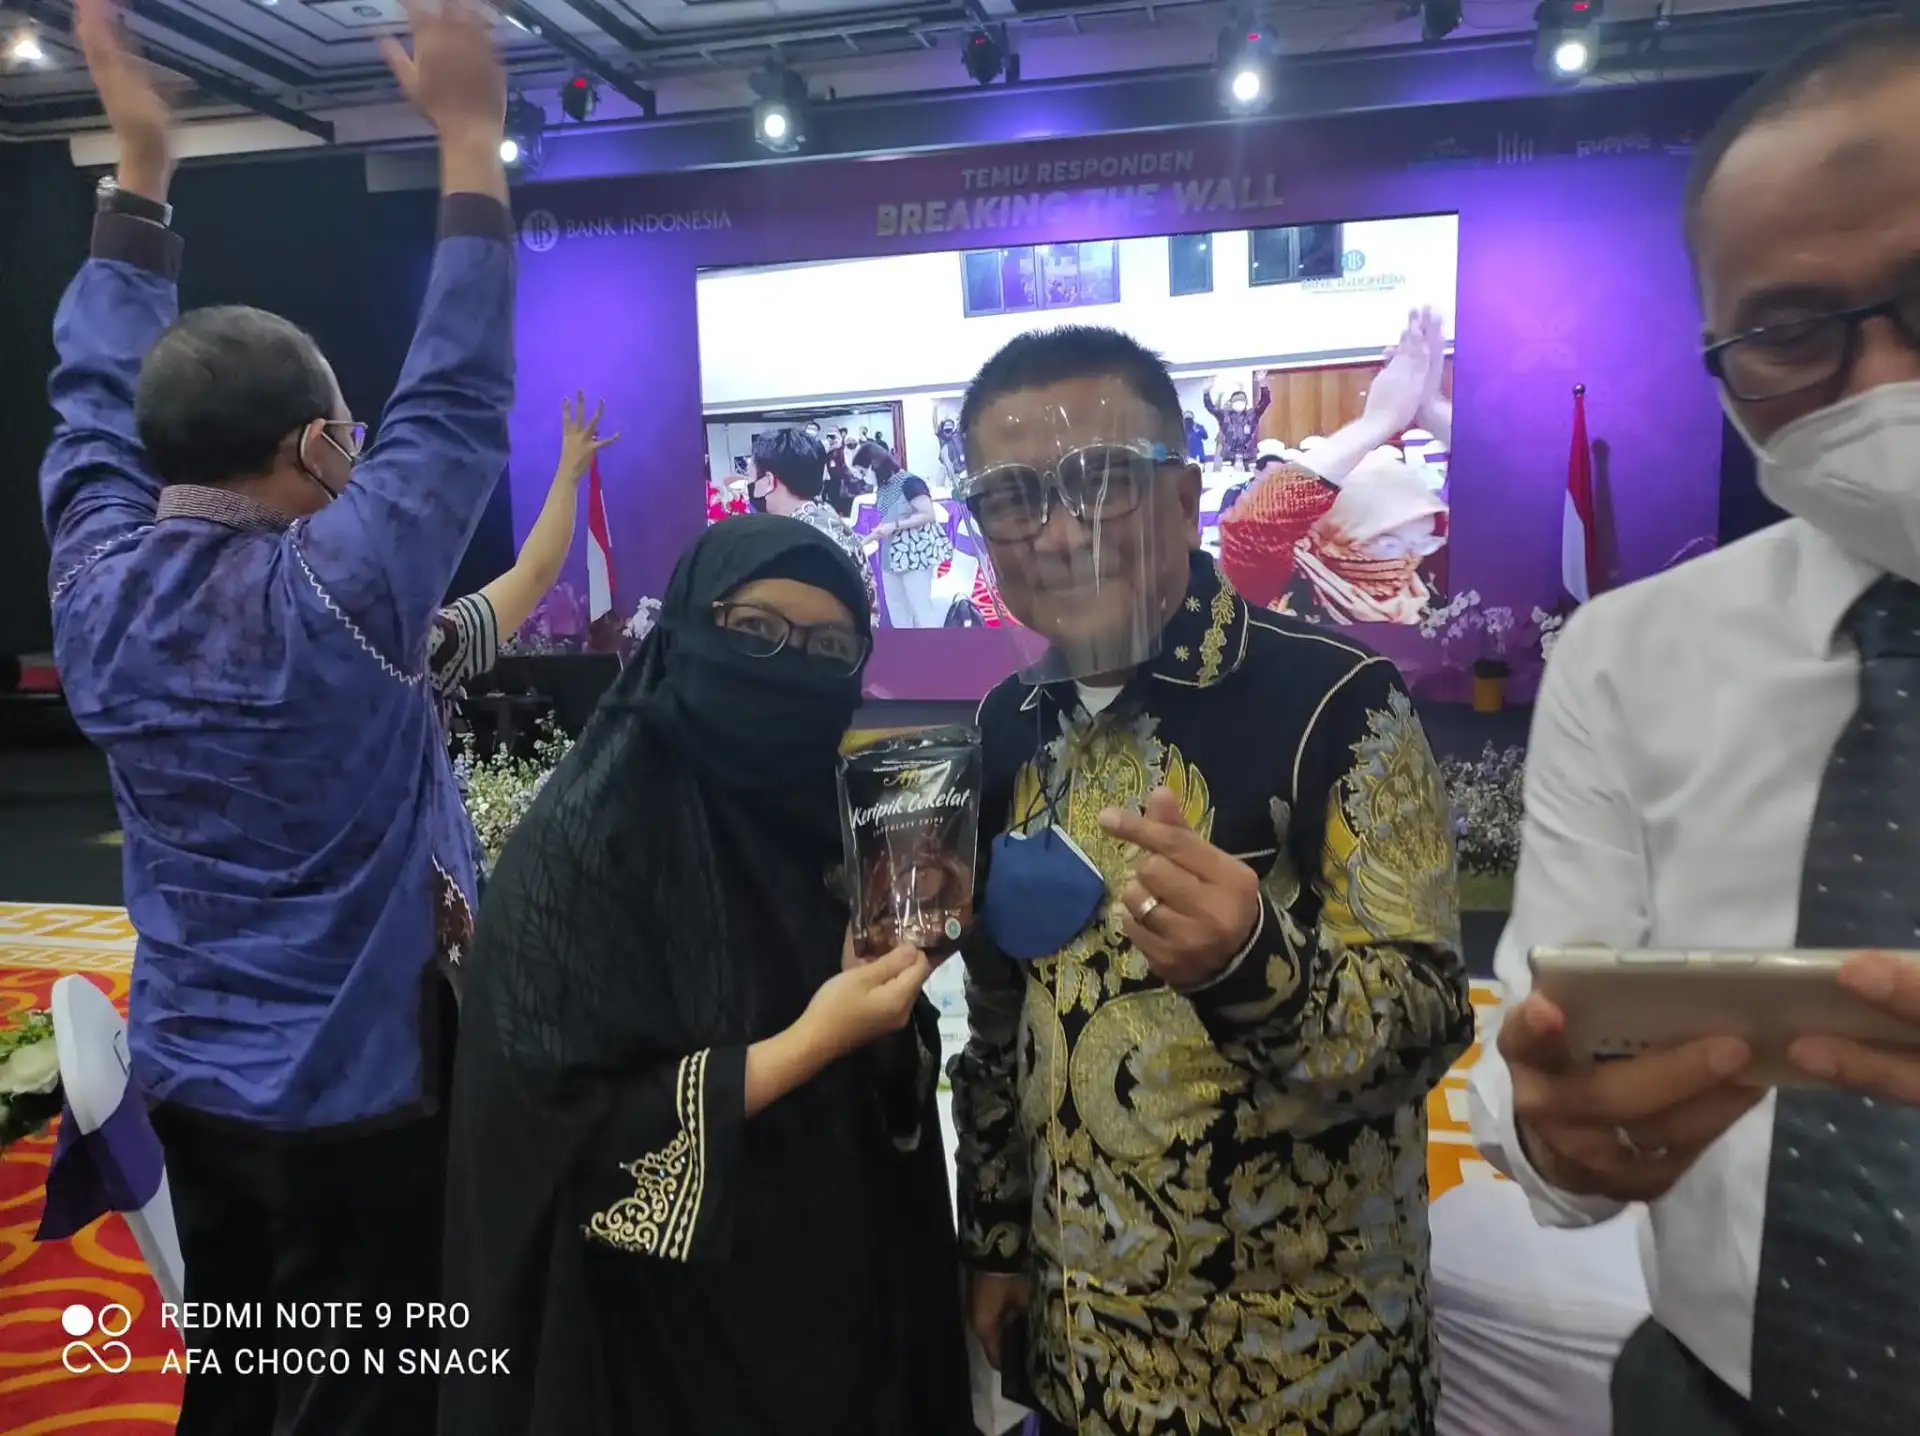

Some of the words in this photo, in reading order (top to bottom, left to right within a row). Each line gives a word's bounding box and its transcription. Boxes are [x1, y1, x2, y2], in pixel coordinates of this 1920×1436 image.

[962, 165, 1028, 190] TEMU
[1037, 151, 1194, 184] RESPONDEN
[566, 216, 617, 239] BANK
[624, 207, 732, 235] INDONESIA
[875, 191, 1070, 237] BREAKING
[1173, 173, 1285, 214] WALL
